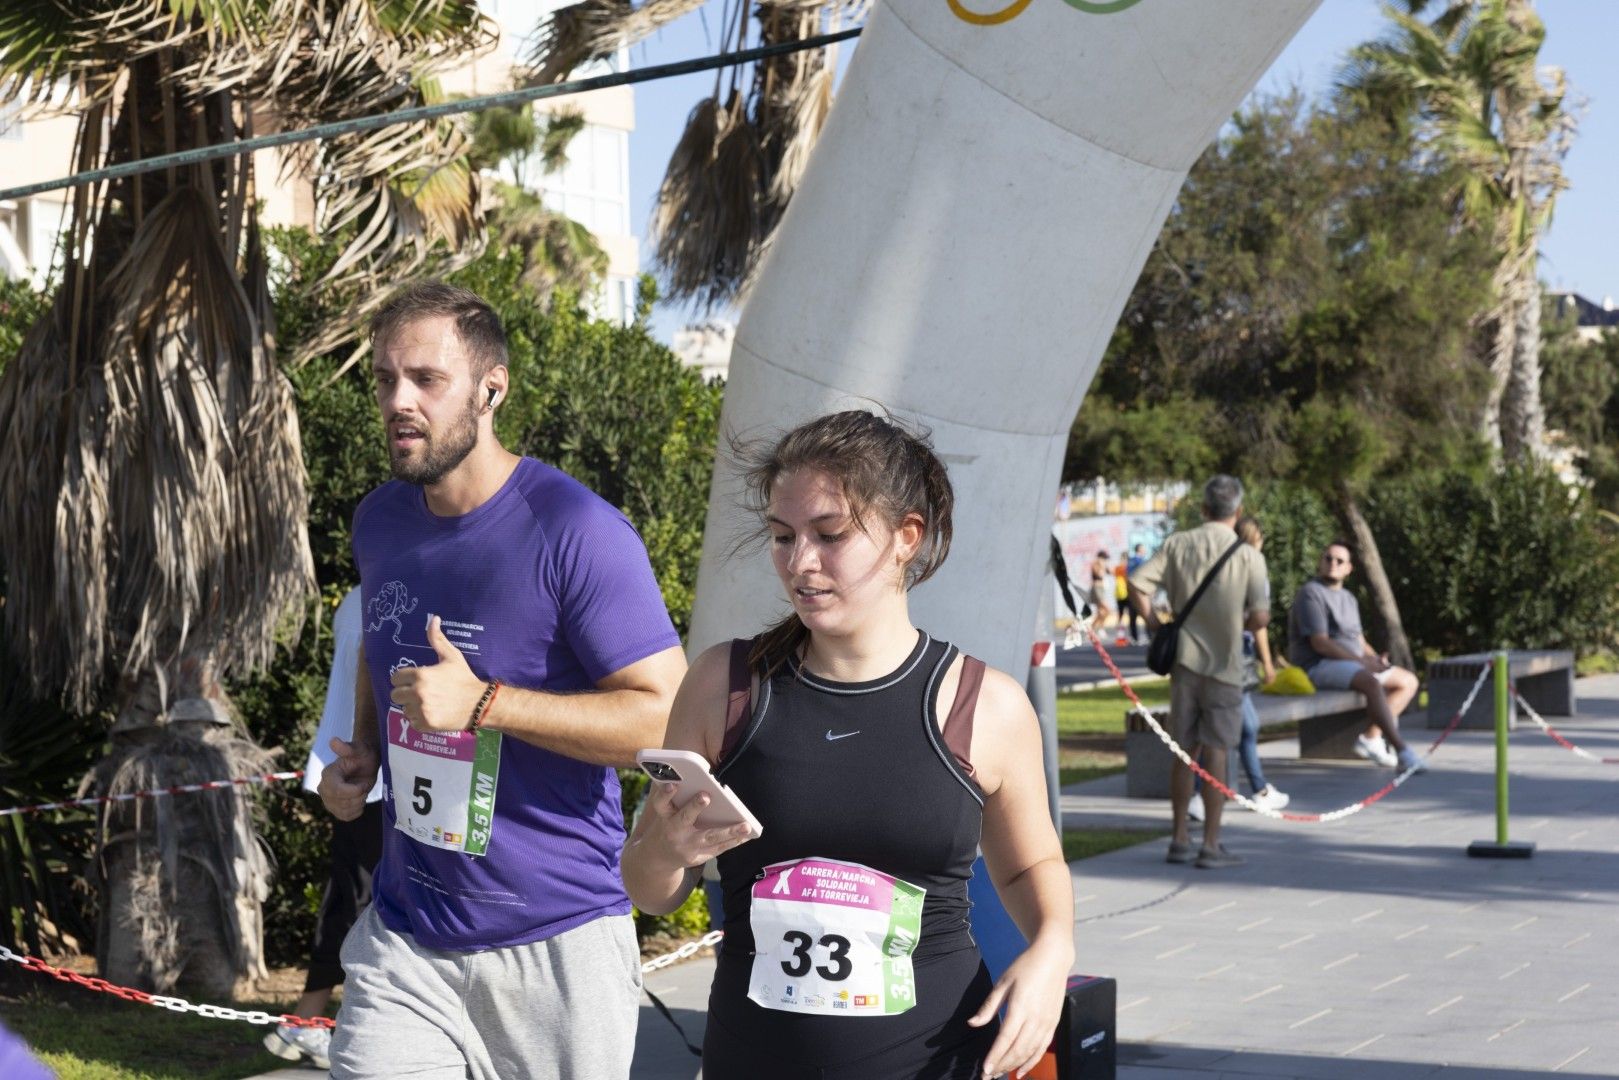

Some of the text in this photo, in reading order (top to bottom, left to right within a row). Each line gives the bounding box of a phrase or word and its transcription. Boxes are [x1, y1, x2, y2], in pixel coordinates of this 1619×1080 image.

[399, 718, 410, 744] X
[421, 733, 448, 745] SOLIDARIA
[413, 740, 457, 755] AFA TORREVIEJA
[413, 776, 433, 816] 5
[472, 772, 494, 845] 3,5 KM
[772, 867, 795, 895] X
[802, 866, 876, 886] CARRERA/MARCHA
[816, 879, 857, 892] SOLIDARIA
[801, 888, 870, 904] AFA TORREVIEJA
[781, 930, 853, 982] 33
